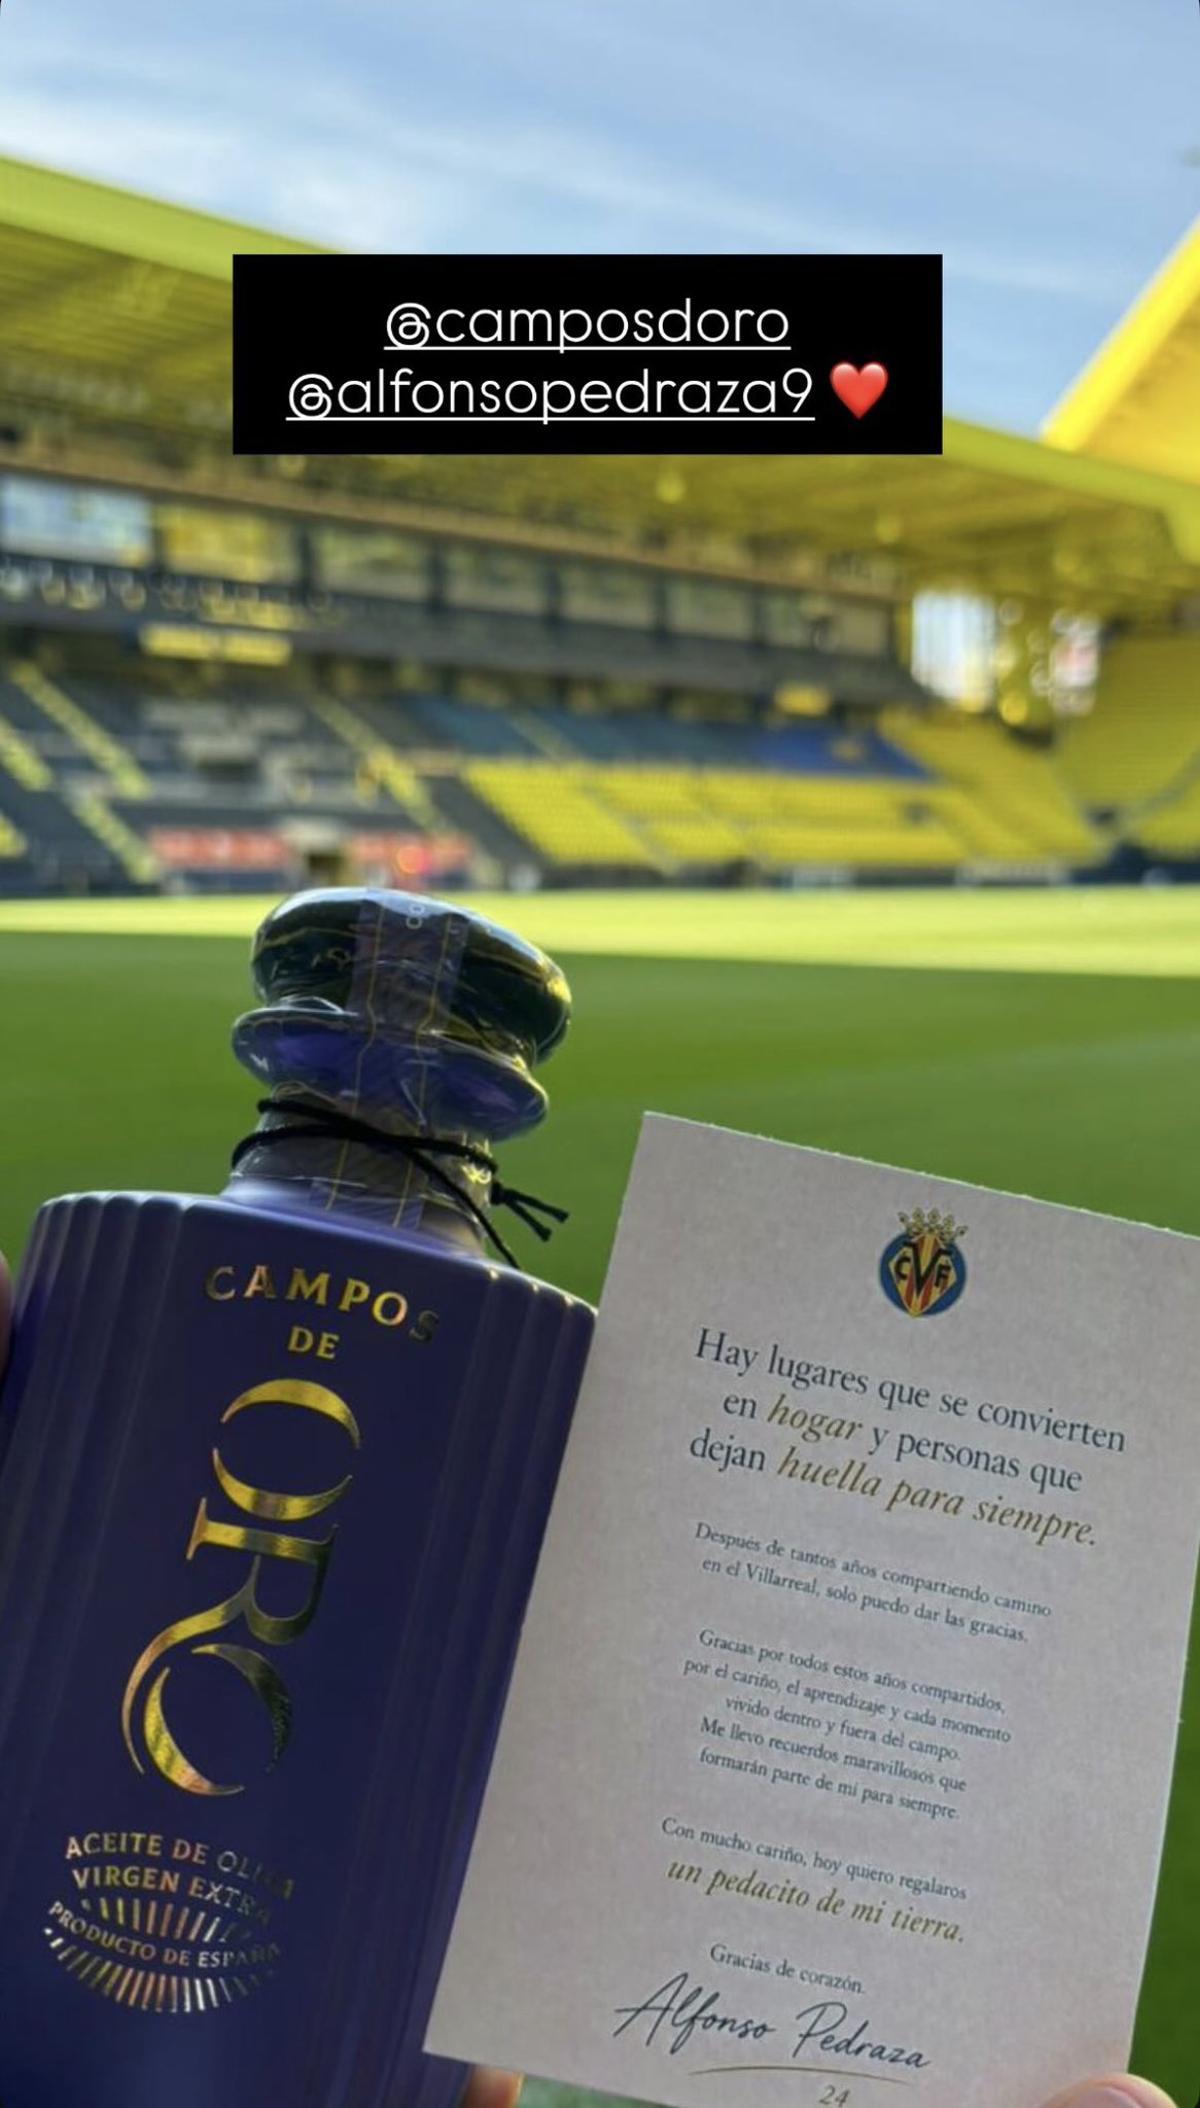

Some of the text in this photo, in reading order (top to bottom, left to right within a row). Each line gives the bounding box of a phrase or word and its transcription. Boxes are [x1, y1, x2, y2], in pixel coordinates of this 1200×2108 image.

[205, 1264, 440, 1343] CAMPOS
[287, 1326, 340, 1359] DE
[694, 1327, 1126, 1453] Hay lugares que se convierten
[722, 1391, 1083, 1495] en hogar y personas que
[689, 1426, 1098, 1547] dejan huella para siempre.
[121, 1378, 361, 1797] ORO
[695, 1522, 1053, 1618] Después de tantos años compartiendo camino
[702, 1557, 1030, 1644] en el Villarreal, solo puedo dar las gracias.
[683, 1658, 1012, 1744] por el cariño, el aprendizaje y cada momento
[699, 1628, 1006, 1715] Gracias por todos estos años compartidos,
[699, 1716, 967, 1793] Me llevo recuerdos maravillosos que
[726, 1696, 962, 1763] vivido dentro y fuera del campo.
[699, 1746, 768, 1777] formarán
[770, 1767, 811, 1785] parte
[814, 1774, 834, 1792] de
[860, 1788, 894, 1806] para
[898, 1793, 961, 1820] siempre.
[65, 1832, 295, 1900] ACEITE DE OLI
[72, 1865, 181, 1895] VIRGEN
[662, 1817, 968, 1901] Con mucho cariño, hoy quiero regalaros
[49, 1900, 157, 1961] PRODUCTO
[162, 1947, 191, 1967] DE
[666, 1860, 966, 1944] un pedacito de mi tierra.
[709, 1943, 867, 1996] Gracias de corazón.
[613, 1971, 931, 2070] Alfonso Pedraza
[818, 2084, 851, 2108] 24
